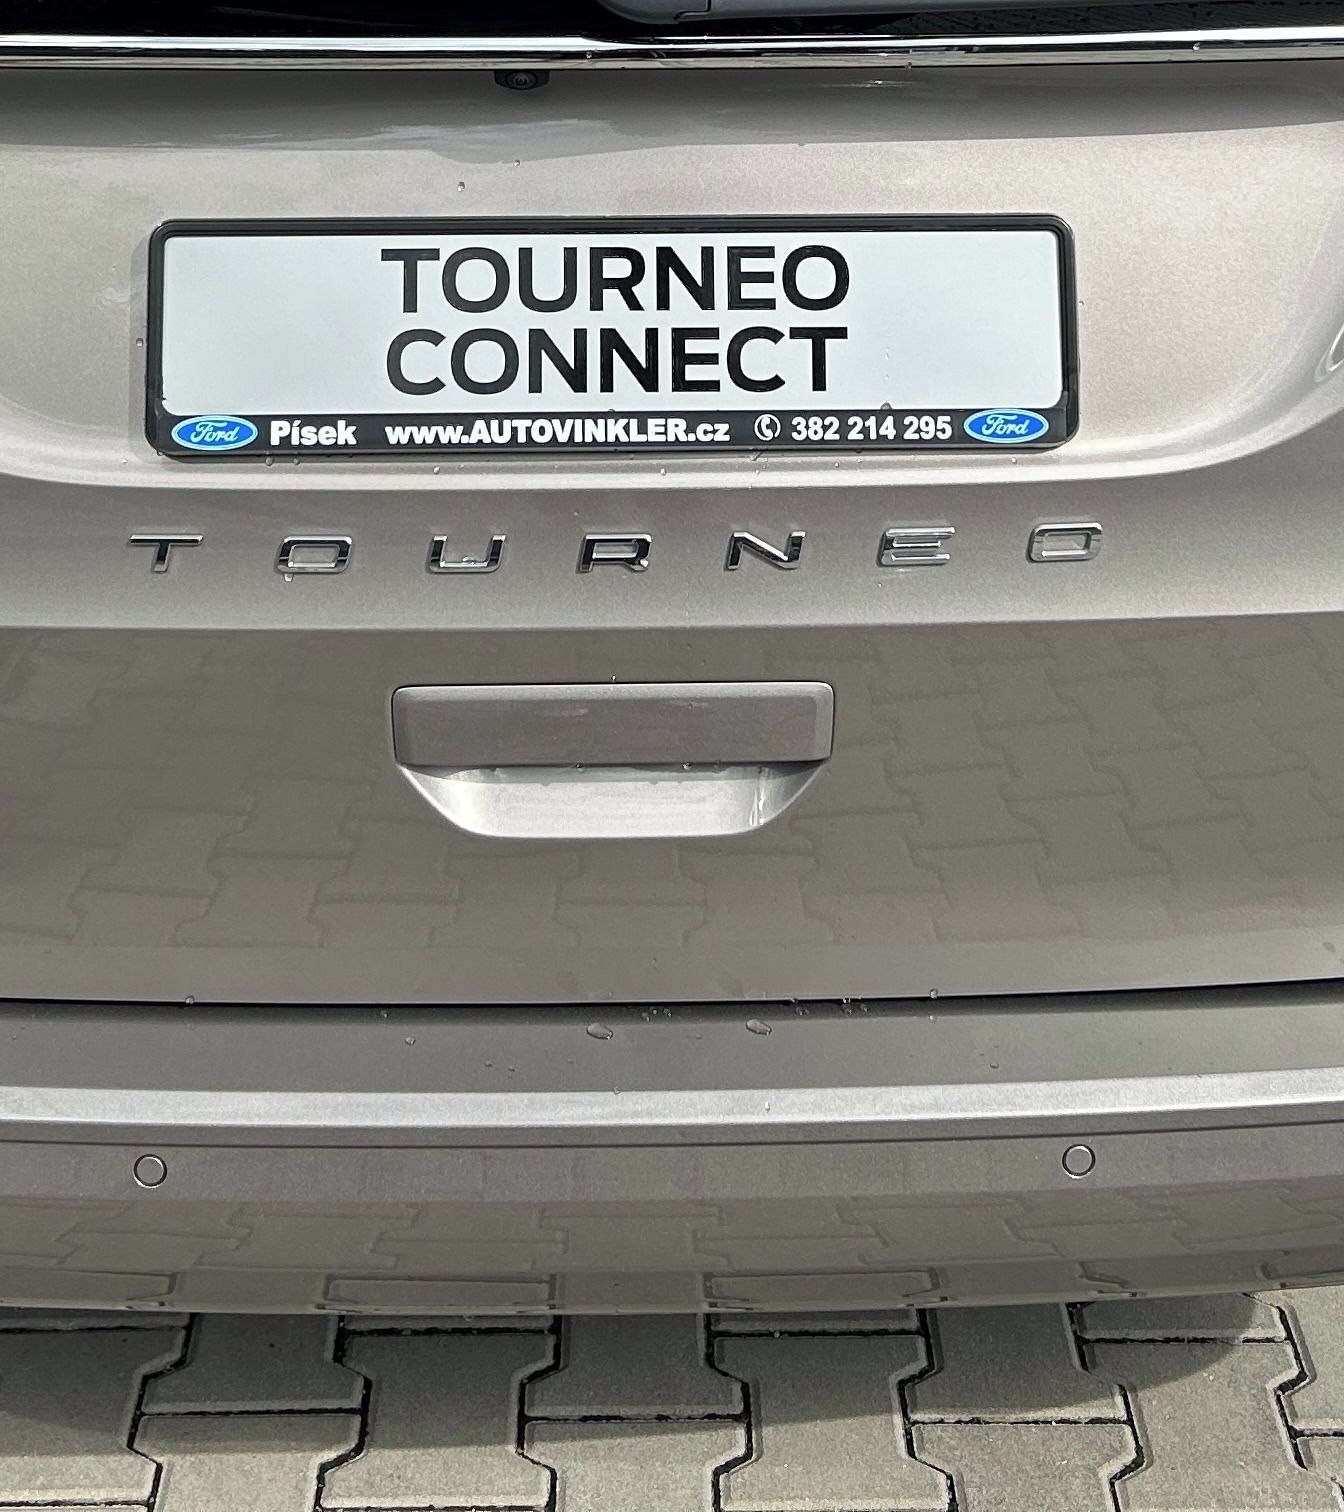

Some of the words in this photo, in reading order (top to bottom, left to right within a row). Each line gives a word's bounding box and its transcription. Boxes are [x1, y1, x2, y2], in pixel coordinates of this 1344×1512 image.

[381, 245, 849, 314] TOURNEO
[387, 326, 848, 396] CONNECT
[190, 421, 240, 443] Ford
[271, 419, 357, 446] Písek
[385, 417, 731, 445] www.AUTOVINKLER.cz
[791, 416, 840, 441] 382
[847, 416, 897, 440] 214
[903, 415, 953, 440] 295
[982, 414, 1030, 435] Ford
[128, 520, 1103, 575] TOURNEO
